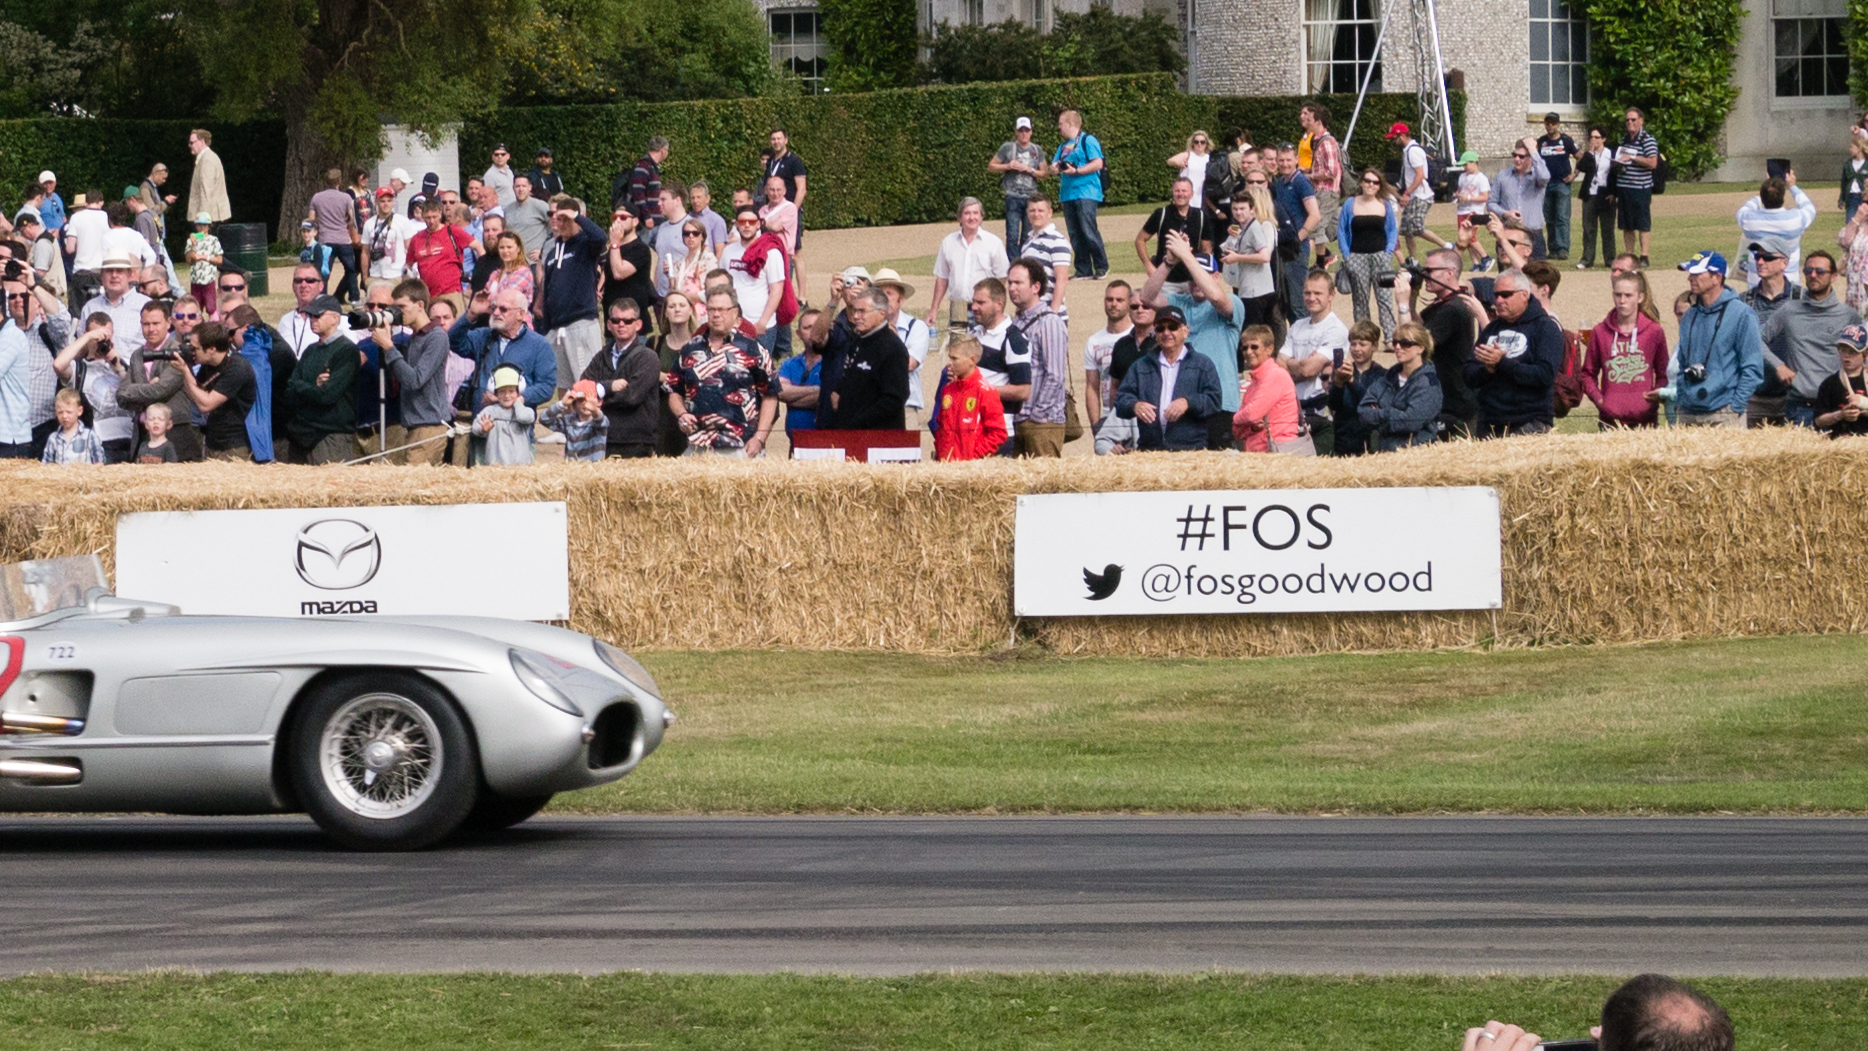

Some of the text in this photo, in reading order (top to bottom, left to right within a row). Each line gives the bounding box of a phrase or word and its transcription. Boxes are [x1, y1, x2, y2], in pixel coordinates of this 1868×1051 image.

[1176, 503, 1333, 551] #FOS
[1141, 560, 1433, 605] @fosgoodwood
[48, 646, 75, 659] 722
